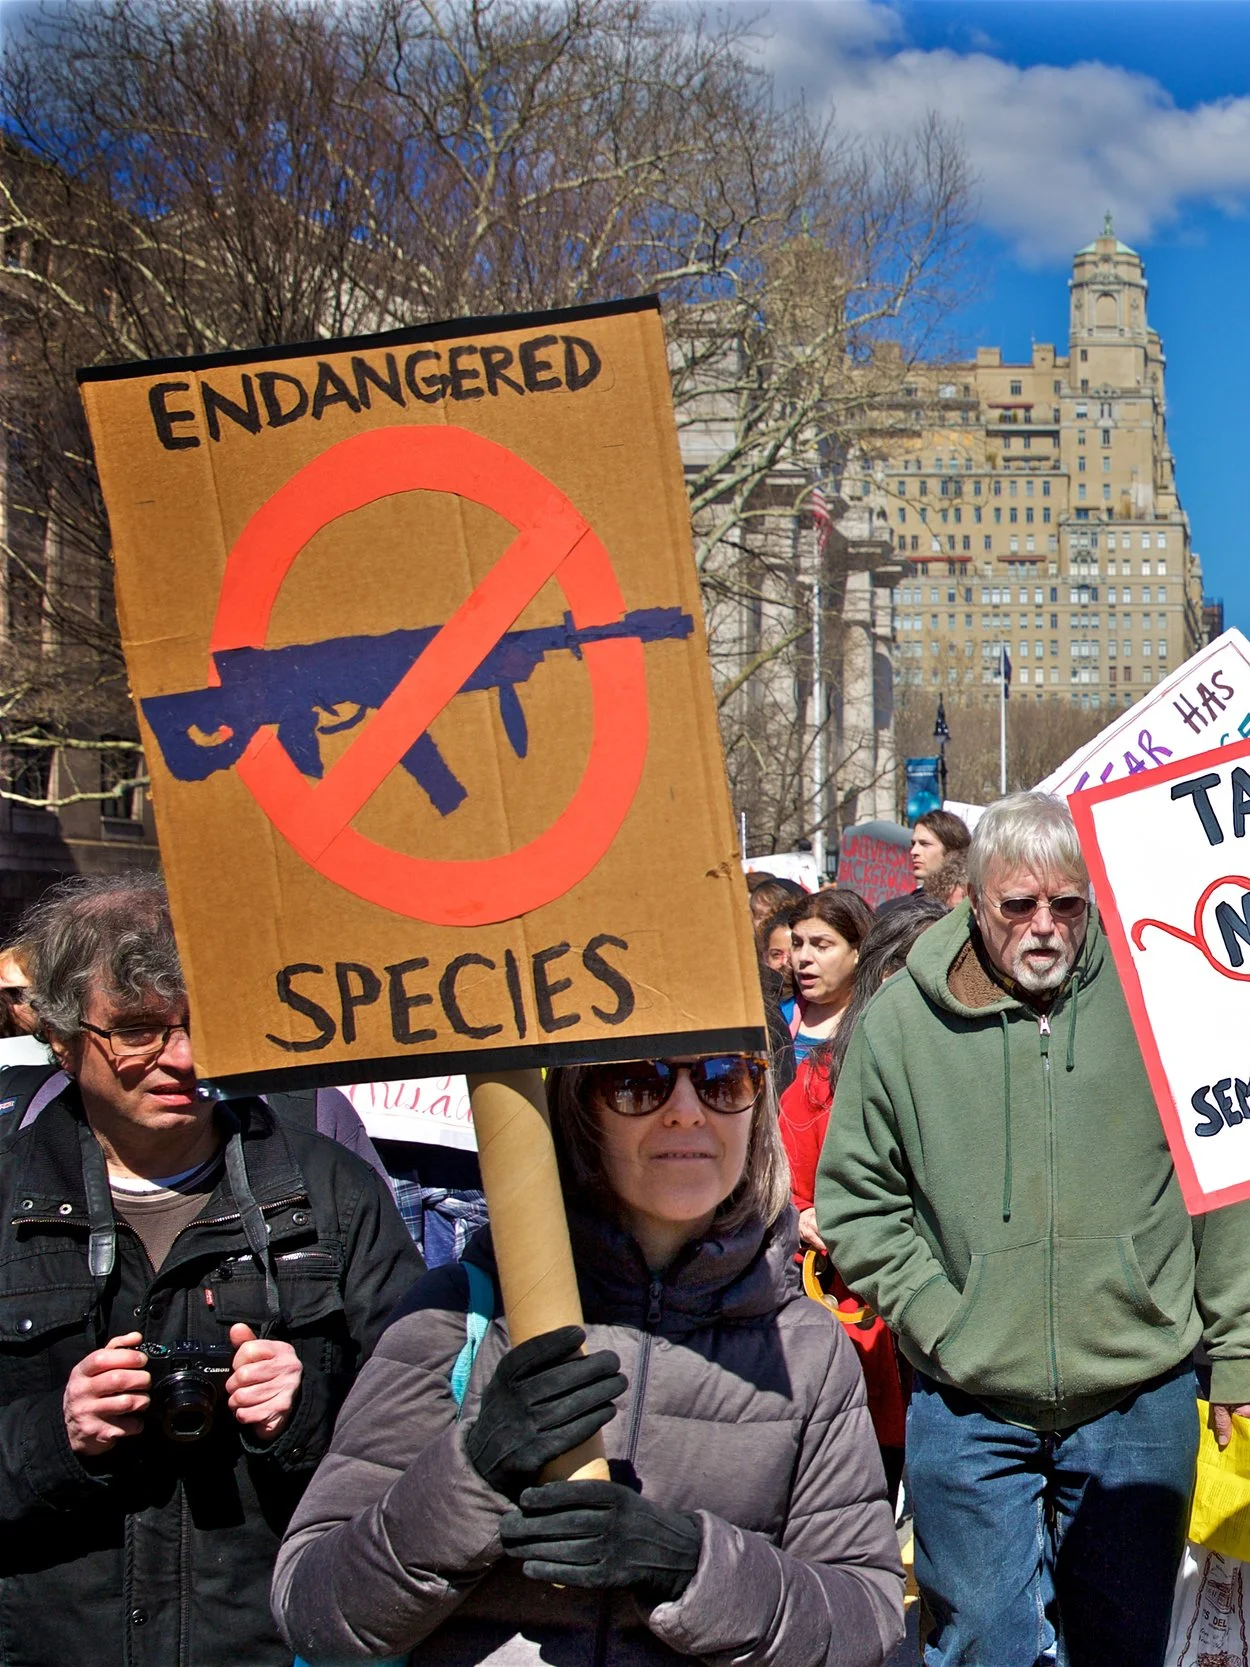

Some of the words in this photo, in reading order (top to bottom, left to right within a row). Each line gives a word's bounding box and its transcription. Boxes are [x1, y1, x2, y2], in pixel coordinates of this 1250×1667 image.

[148, 334, 602, 450] ENDANGERED
[1173, 669, 1235, 735] HAS
[265, 933, 635, 1052] SPECIES
